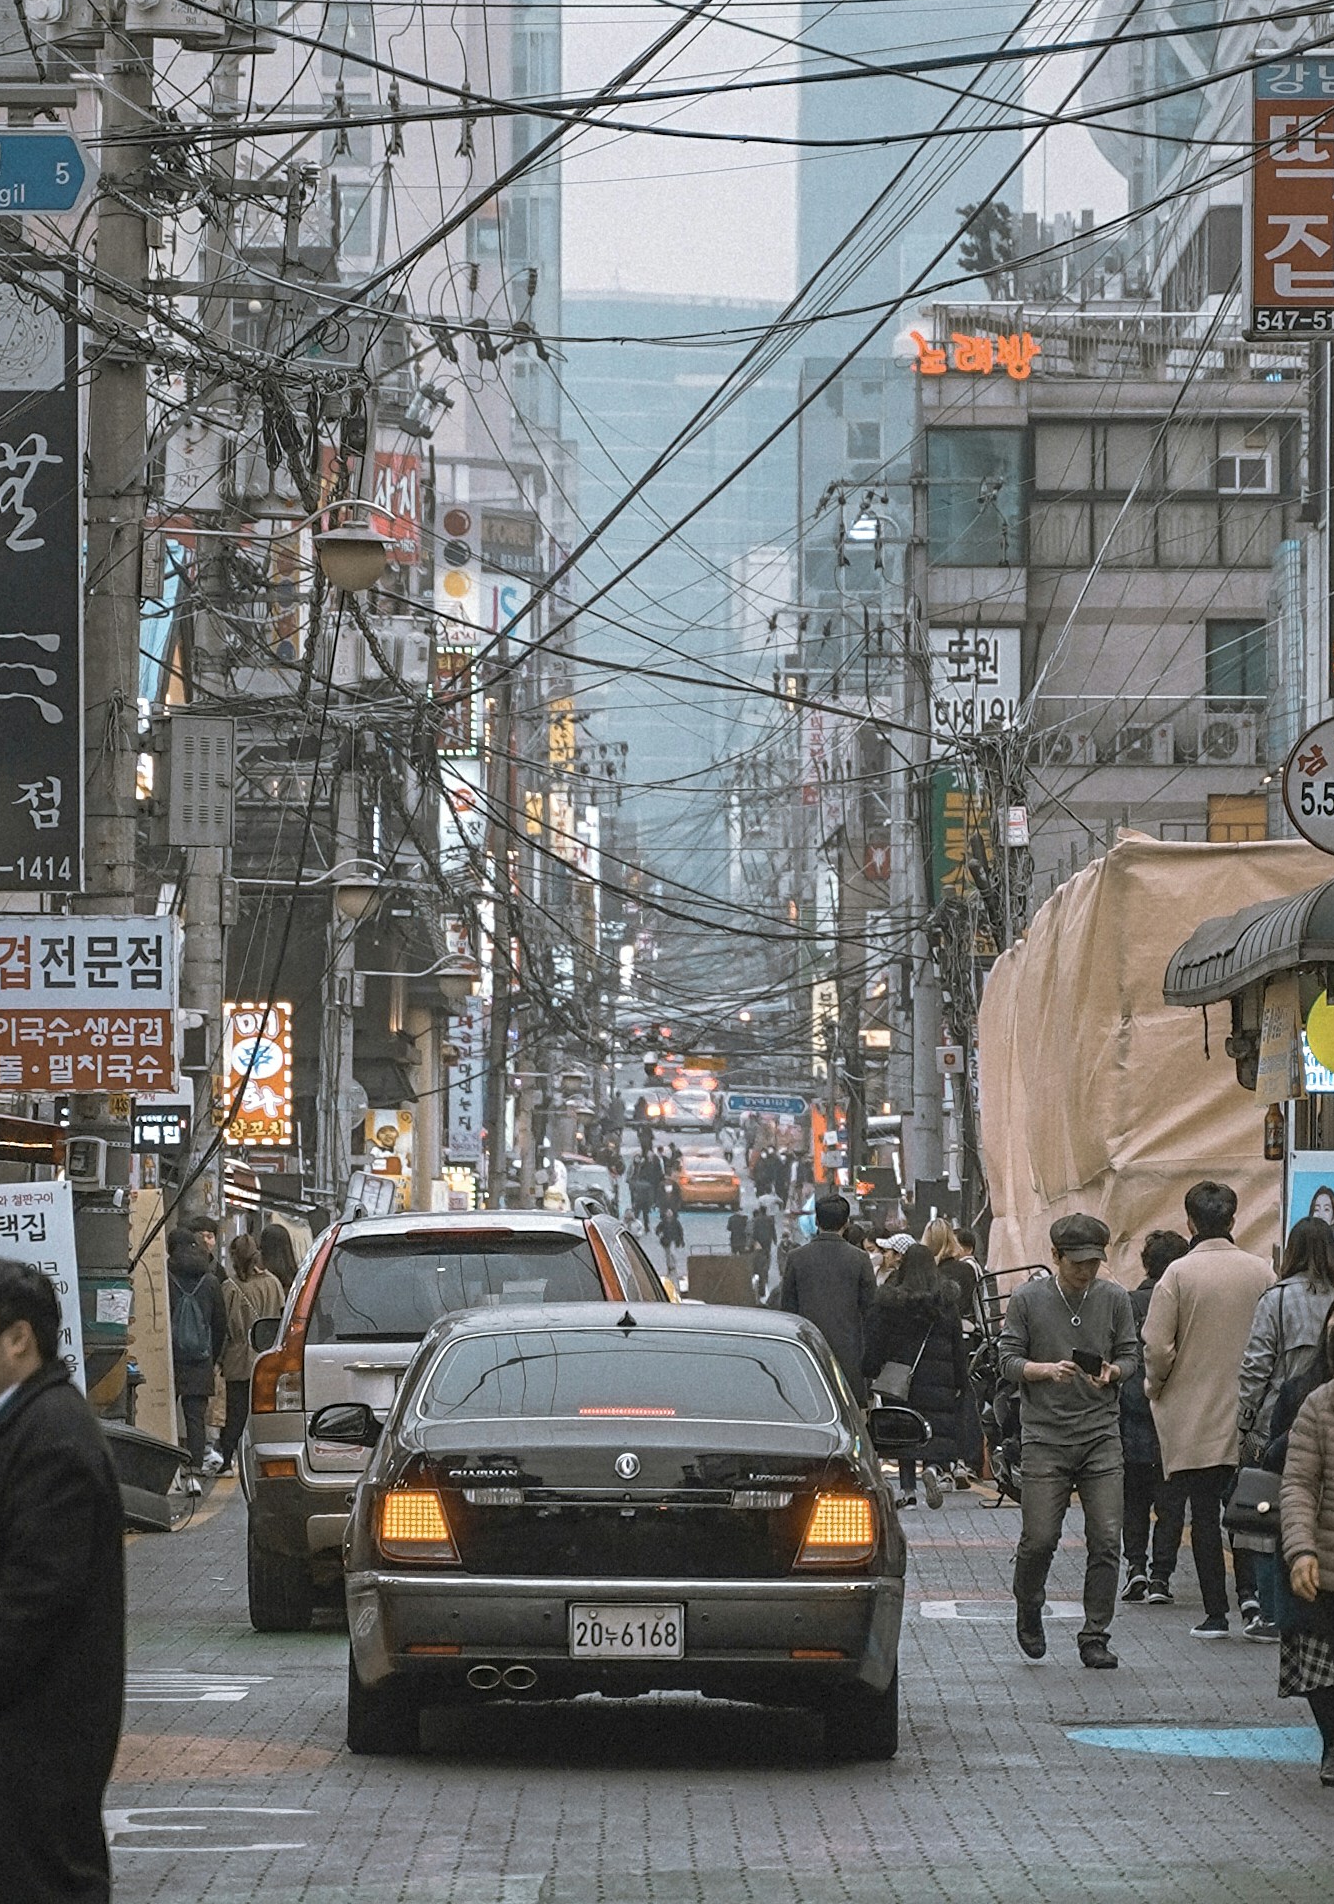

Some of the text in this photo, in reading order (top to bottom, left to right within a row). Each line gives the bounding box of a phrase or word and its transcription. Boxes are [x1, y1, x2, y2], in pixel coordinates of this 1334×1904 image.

[55, 162, 70, 185] 5
[911, 330, 1041, 381] 노래방
[49, 1054, 164, 1084] 멸치국수
[576, 1620, 677, 1647] 20누6168
